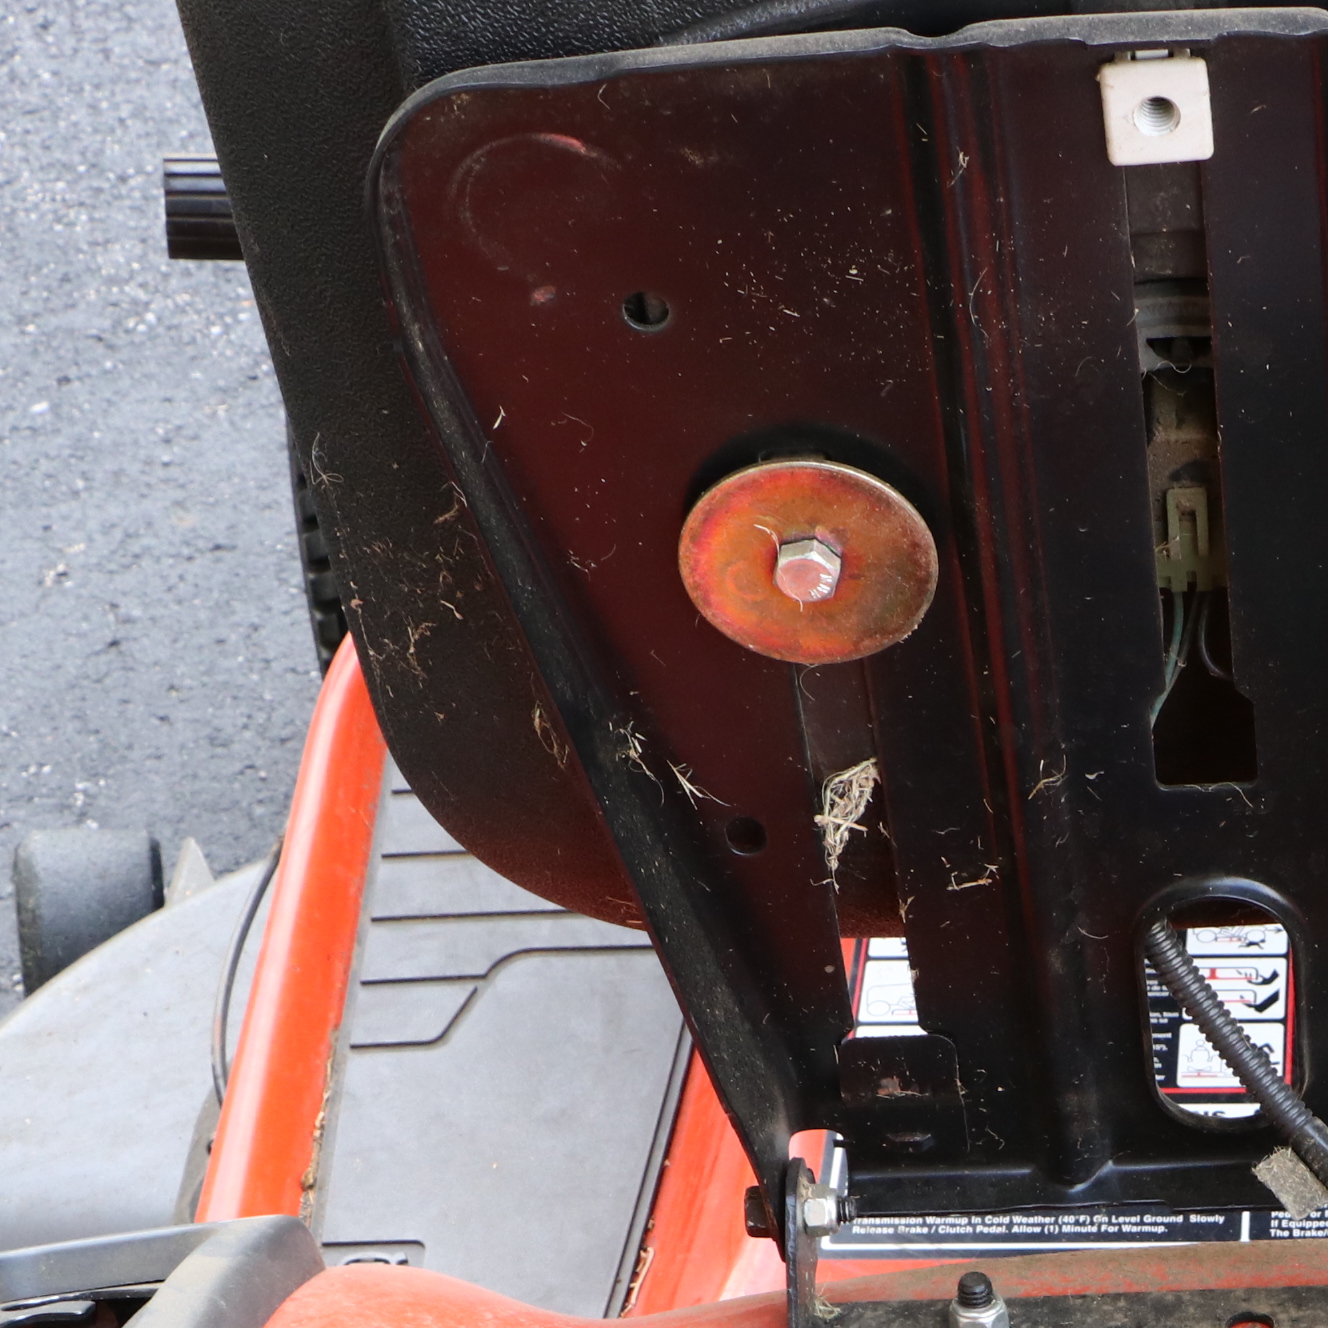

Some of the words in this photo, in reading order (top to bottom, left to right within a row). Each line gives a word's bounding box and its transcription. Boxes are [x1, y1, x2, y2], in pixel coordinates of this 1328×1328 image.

[853, 1217, 923, 1225] Transmission
[925, 1216, 968, 1226] Warmup
[985, 1215, 1009, 1224] Cold
[1012, 1214, 1056, 1223] Weather
[1093, 1214, 1108, 1223] On
[1111, 1214, 1140, 1223] Level
[1143, 1214, 1183, 1223] Ground
[1189, 1214, 1225, 1225] Slowly
[1271, 1219, 1279, 1228] If
[852, 1226, 894, 1234] Release
[898, 1225, 928, 1234] Brake
[938, 1225, 972, 1234] Clutch
[975, 1225, 1009, 1233] Pedal.
[1011, 1225, 1041, 1233] Allow
[1044, 1224, 1059, 1234] (1)
[1062, 1224, 1097, 1233] Minute
[1101, 1224, 1119, 1233] For
[1121, 1224, 1168, 1235] Warmup.
[1270, 1229, 1290, 1237] The
